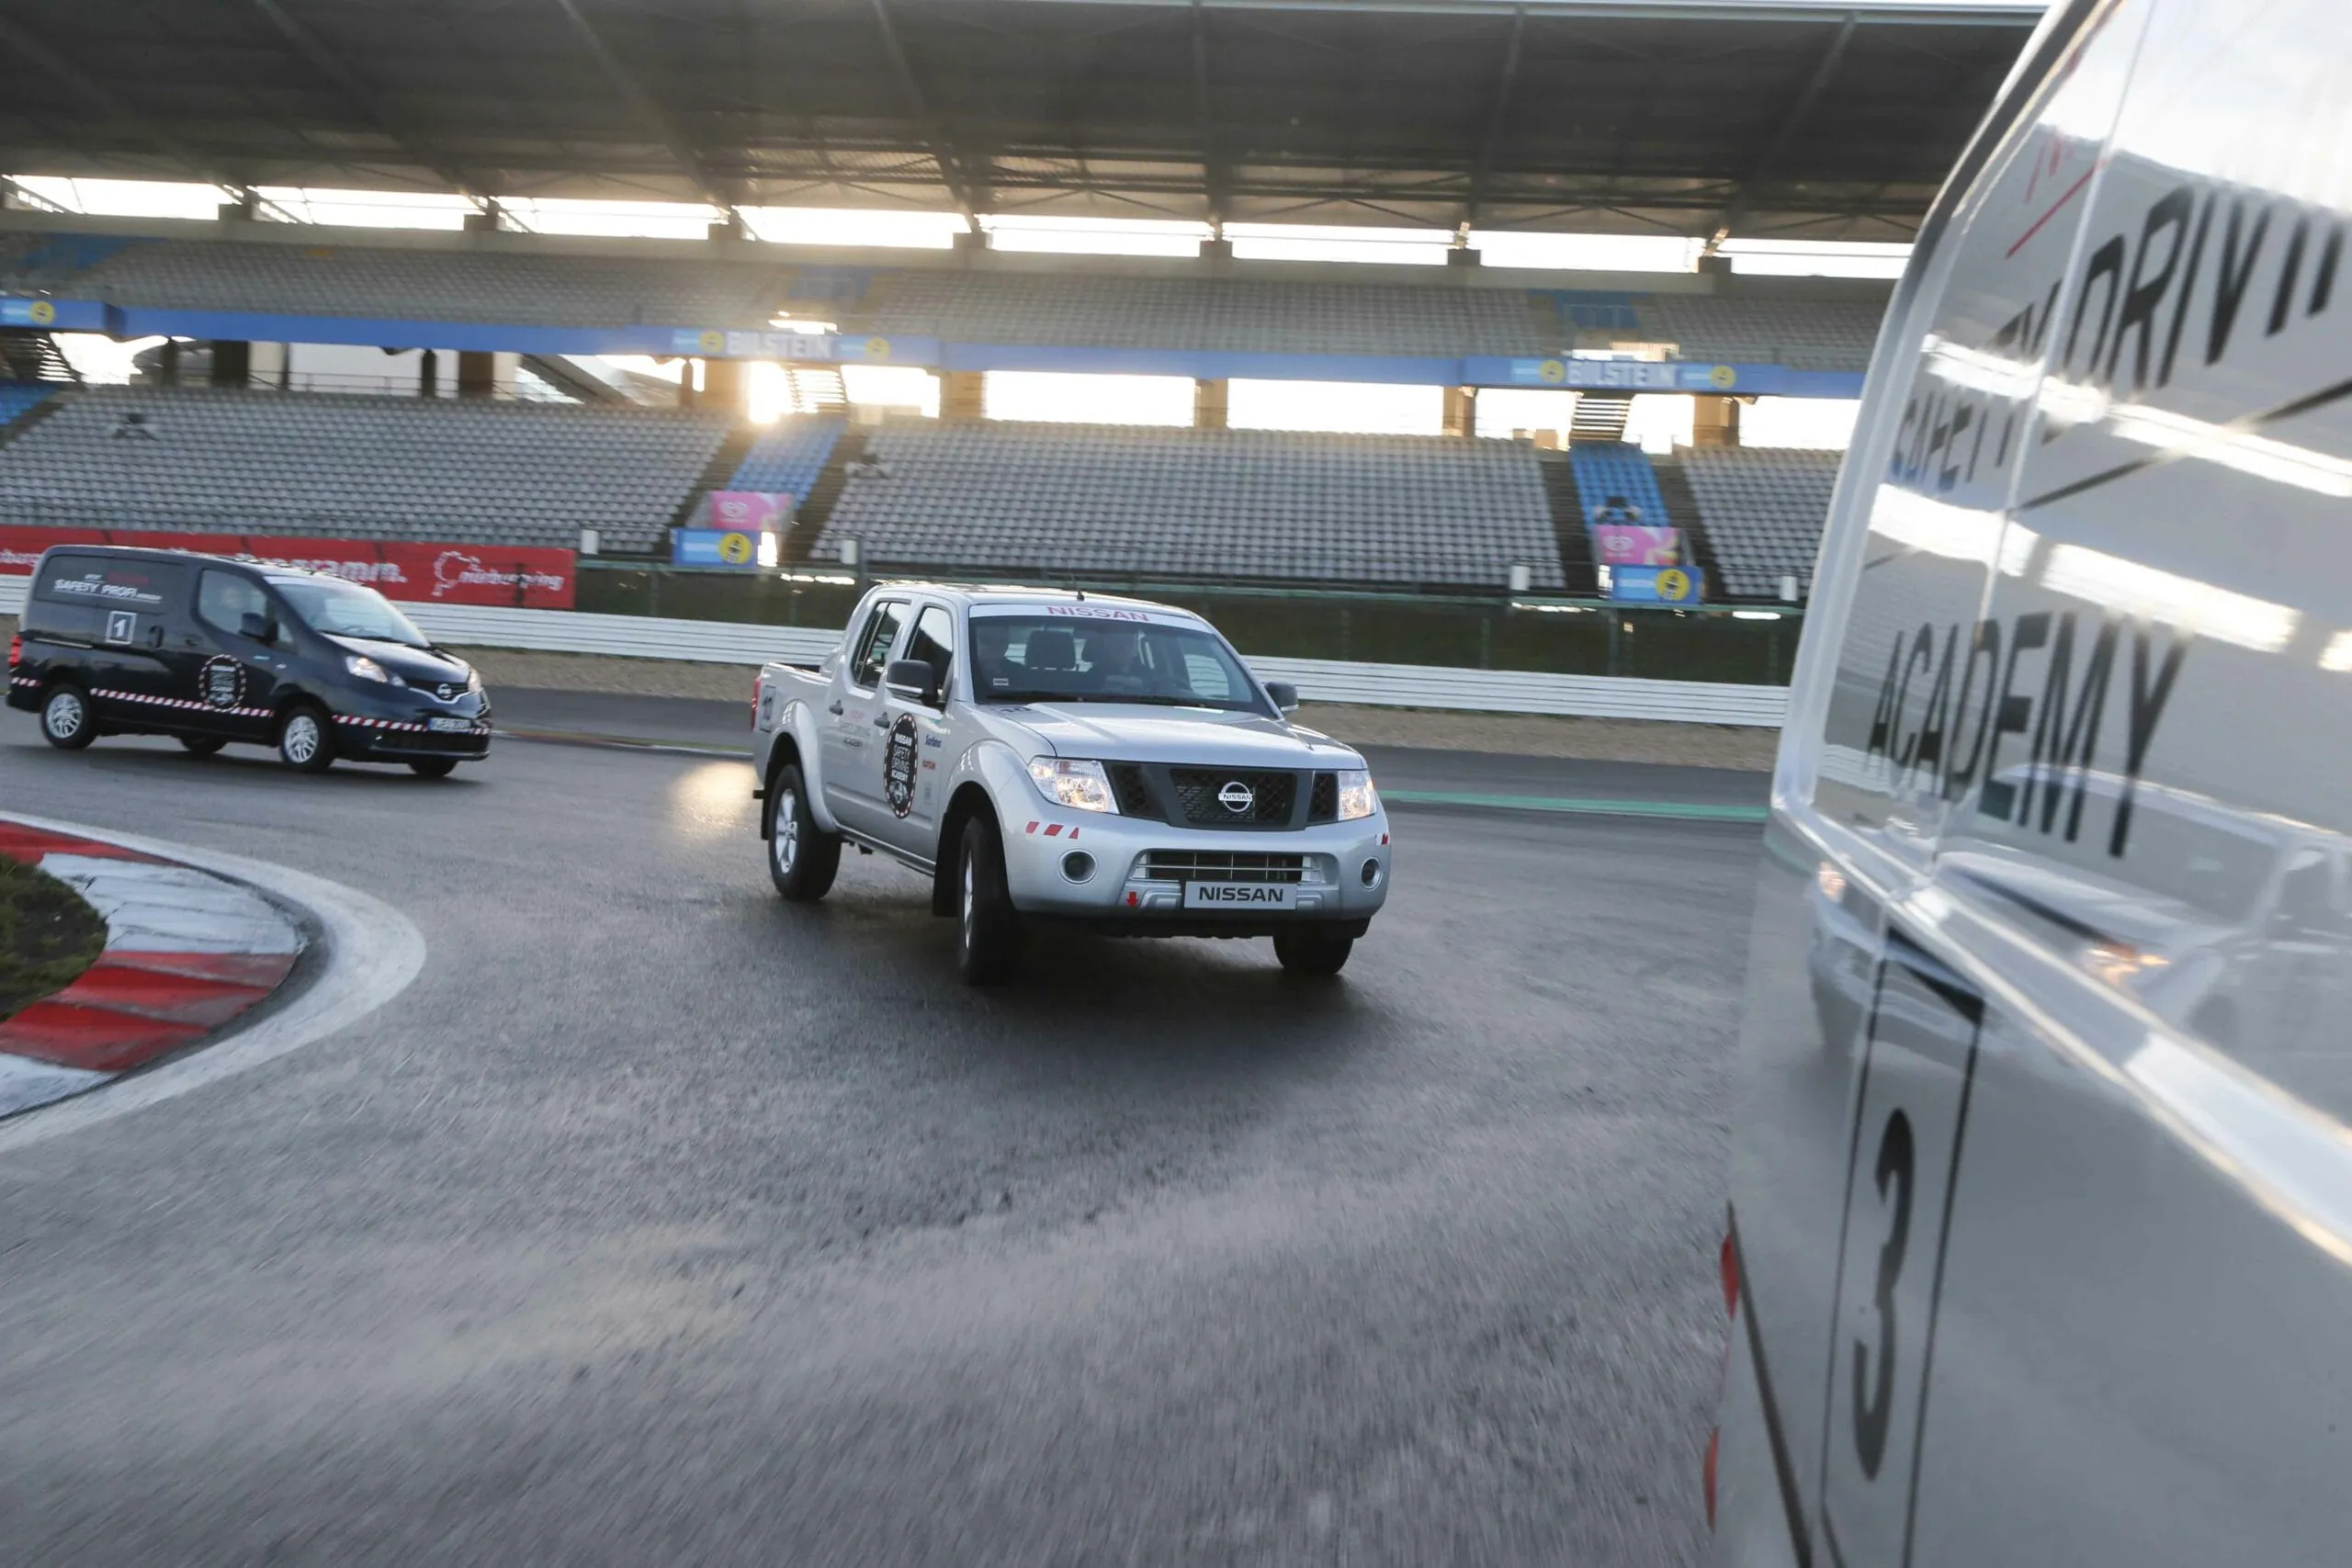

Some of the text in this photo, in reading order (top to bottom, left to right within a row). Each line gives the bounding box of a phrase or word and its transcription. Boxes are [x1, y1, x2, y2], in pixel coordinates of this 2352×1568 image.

[53, 579, 99, 593] SAFETY
[1047, 606, 1148, 622] NISSAN
[114, 619, 126, 637] 1
[1863, 609, 2192, 859] ACADEMY
[1223, 793, 1252, 801] NISSAN
[1198, 886, 1283, 902] NISSAN
[1852, 1108, 1916, 1482] 3
